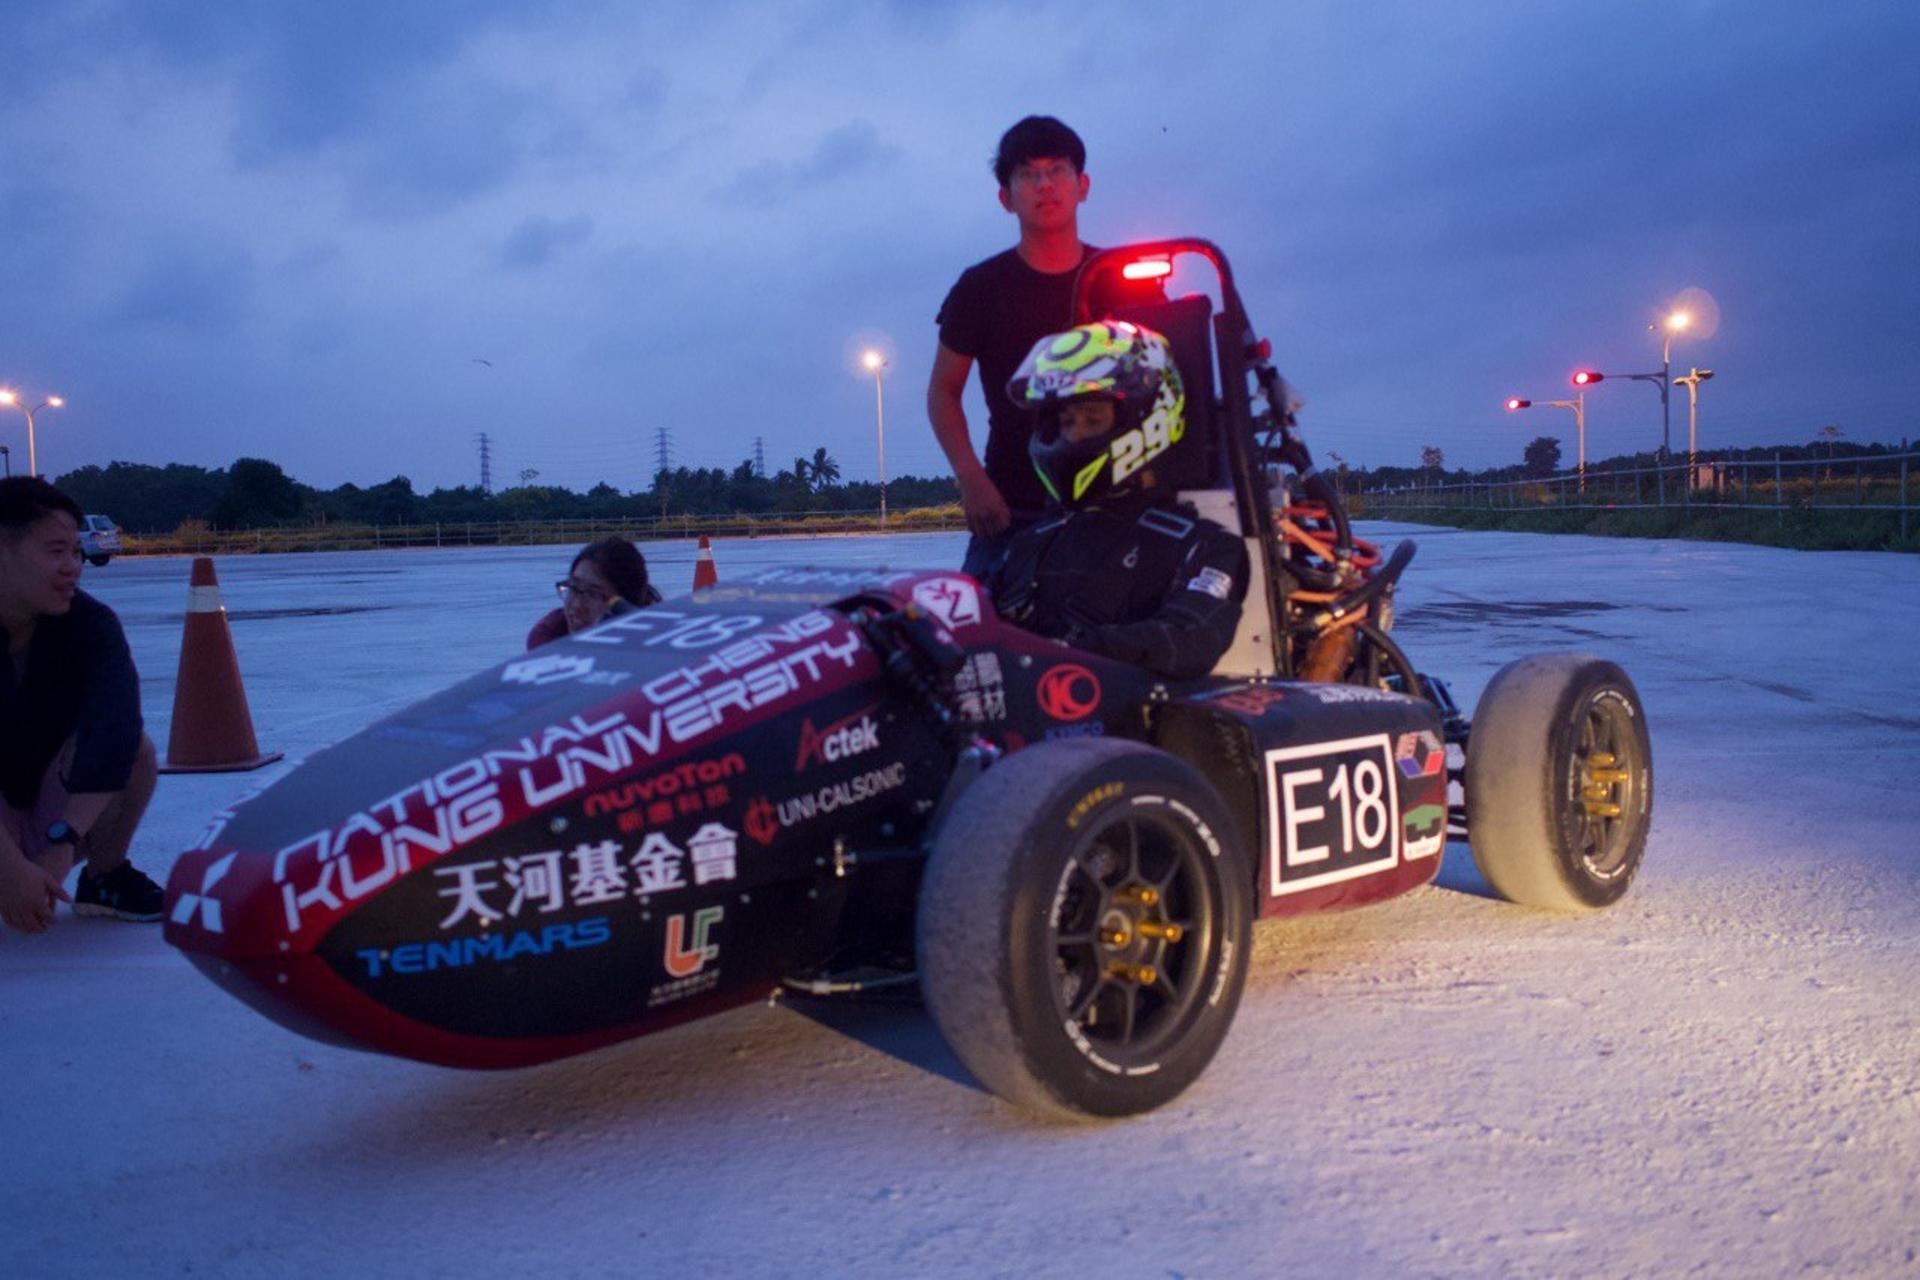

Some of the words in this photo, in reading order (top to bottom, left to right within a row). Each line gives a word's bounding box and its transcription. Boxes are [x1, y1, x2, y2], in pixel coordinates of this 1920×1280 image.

[1111, 405, 1171, 486] 29
[273, 711, 626, 883] NATIONAL
[641, 608, 835, 705] CHENG
[282, 796, 504, 932] KUNG
[521, 629, 862, 806] UNIVERSITY
[794, 710, 880, 770] Actek
[776, 762, 906, 827] UNI-CALSONIC
[1282, 759, 1389, 868] E18
[433, 821, 740, 931] 天河基金會
[355, 916, 613, 979] TENMARS
